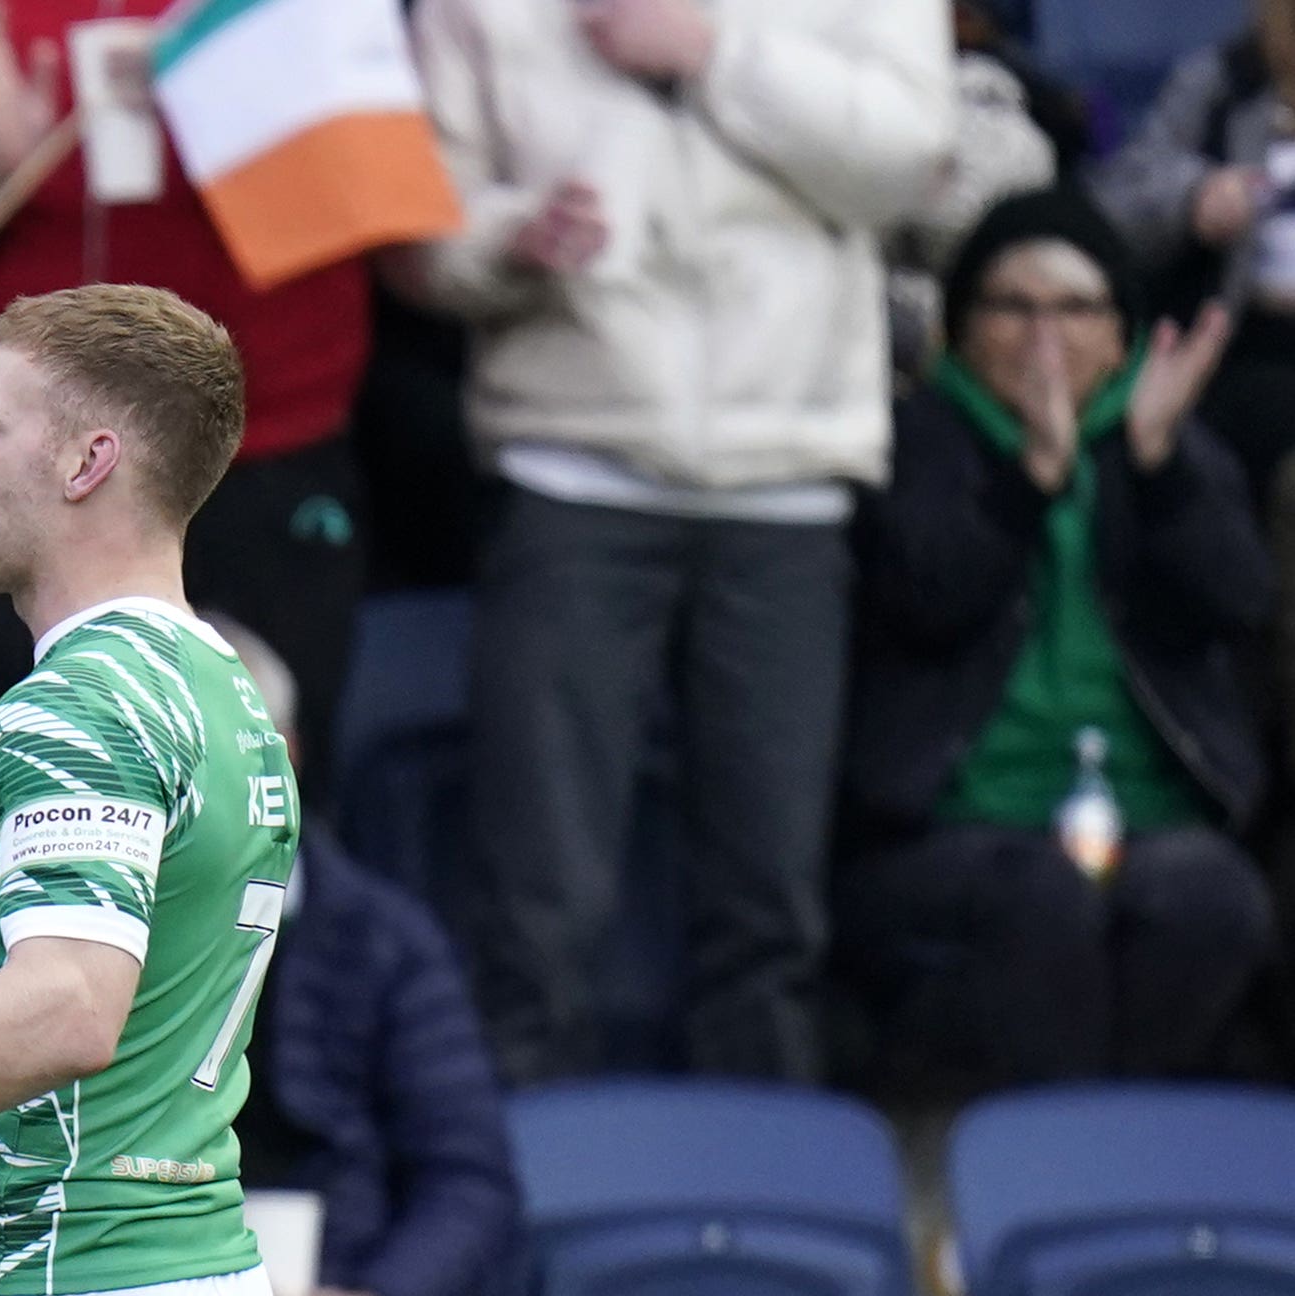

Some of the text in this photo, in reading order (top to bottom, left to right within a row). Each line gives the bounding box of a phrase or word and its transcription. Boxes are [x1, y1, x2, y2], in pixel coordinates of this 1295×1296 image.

[14, 805, 152, 832] Procon 24/7
[12, 840, 149, 862] www.procon247.com
[190, 878, 286, 1092] 7
